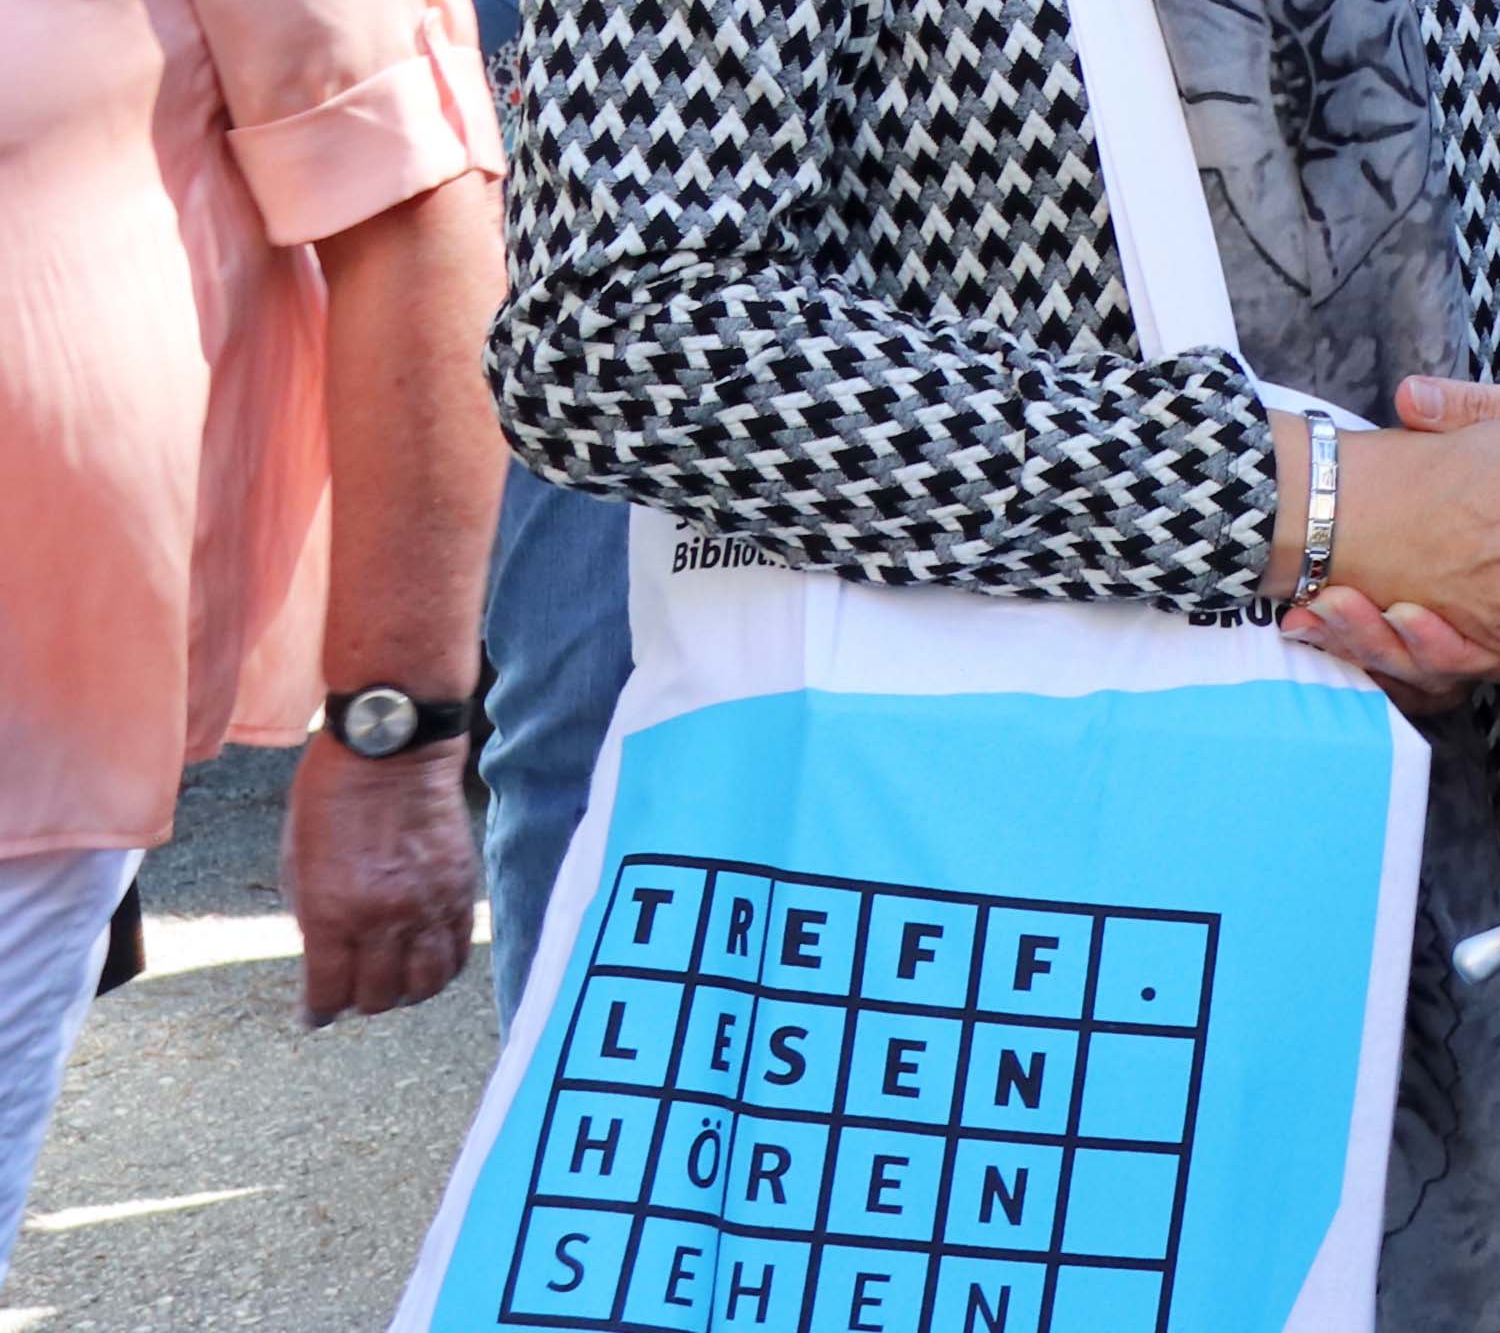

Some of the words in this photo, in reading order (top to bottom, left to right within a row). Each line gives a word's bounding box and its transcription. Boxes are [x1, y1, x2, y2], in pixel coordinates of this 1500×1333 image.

[631, 887, 1157, 1002] TREFF.
[599, 1000, 1046, 1109] LESEN
[568, 1115, 1029, 1226] HÖREN
[545, 1232, 1011, 1333] SEHEN
